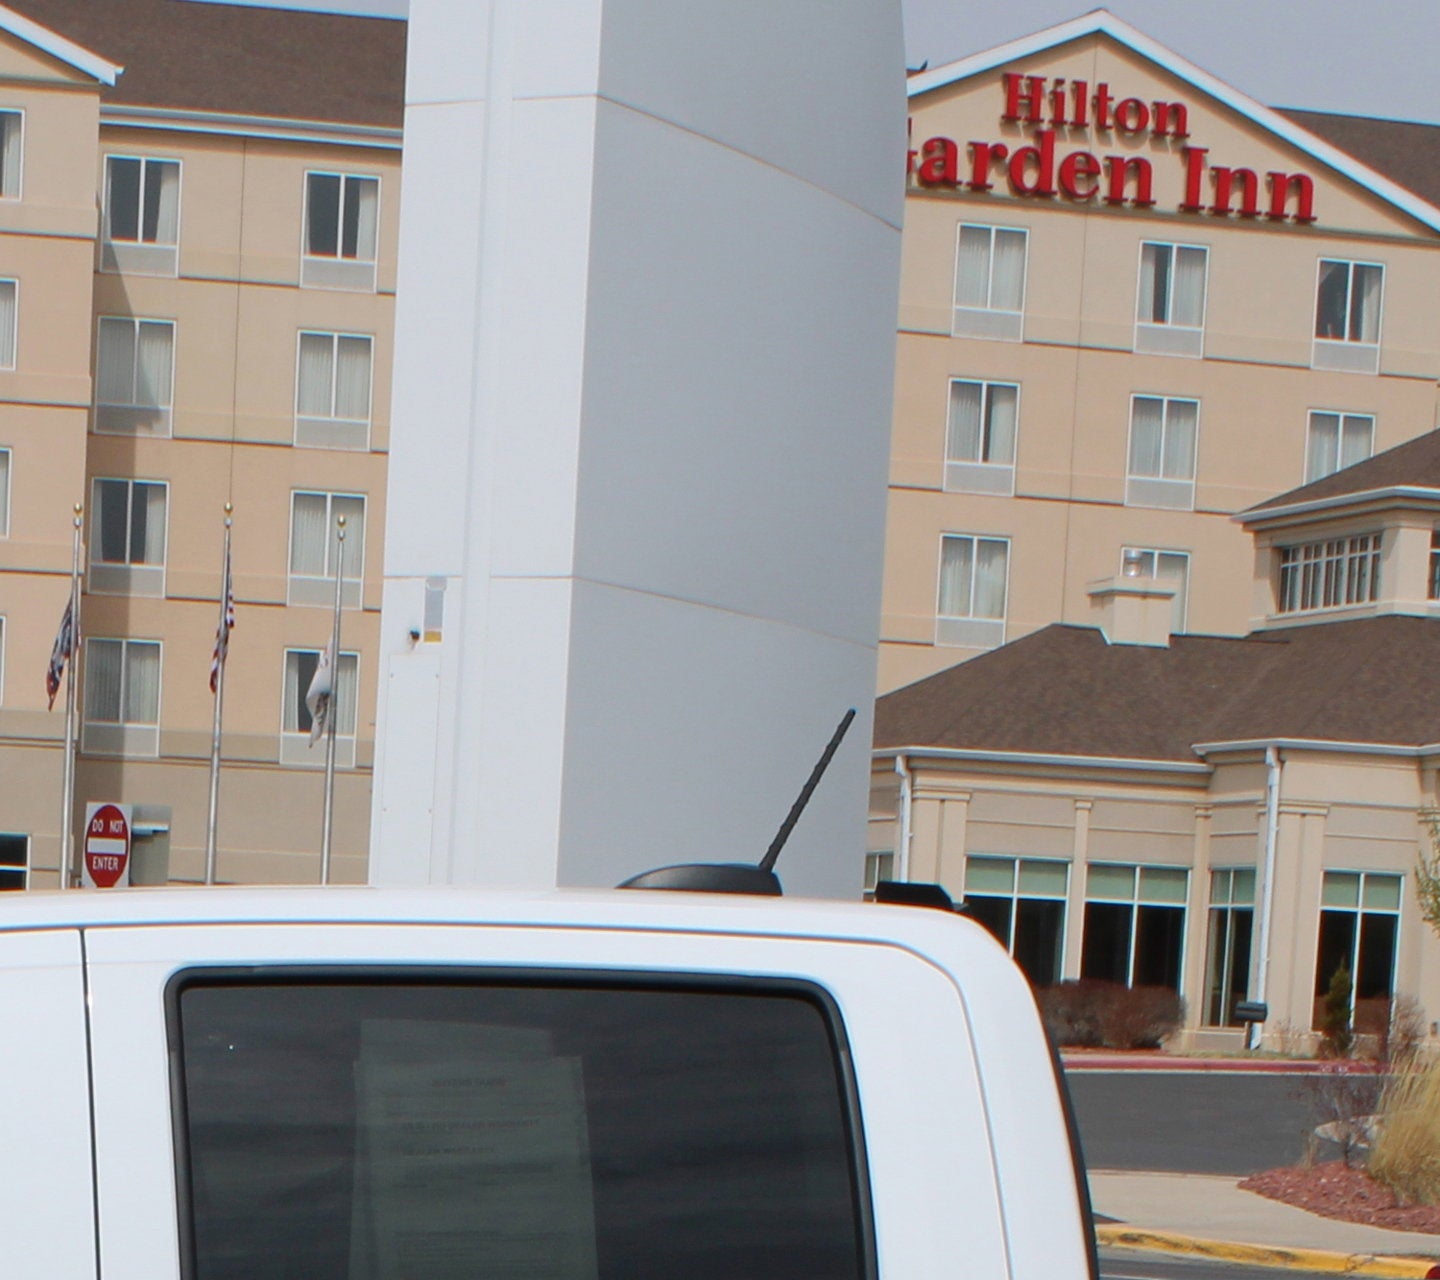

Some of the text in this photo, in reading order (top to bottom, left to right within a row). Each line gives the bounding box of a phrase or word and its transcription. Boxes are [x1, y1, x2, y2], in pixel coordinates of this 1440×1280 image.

[1001, 72, 1190, 138] Hilton
[908, 117, 1317, 223] arden Inn
[92, 819, 124, 833] DO NOT
[92, 856, 119, 871] ENTER
